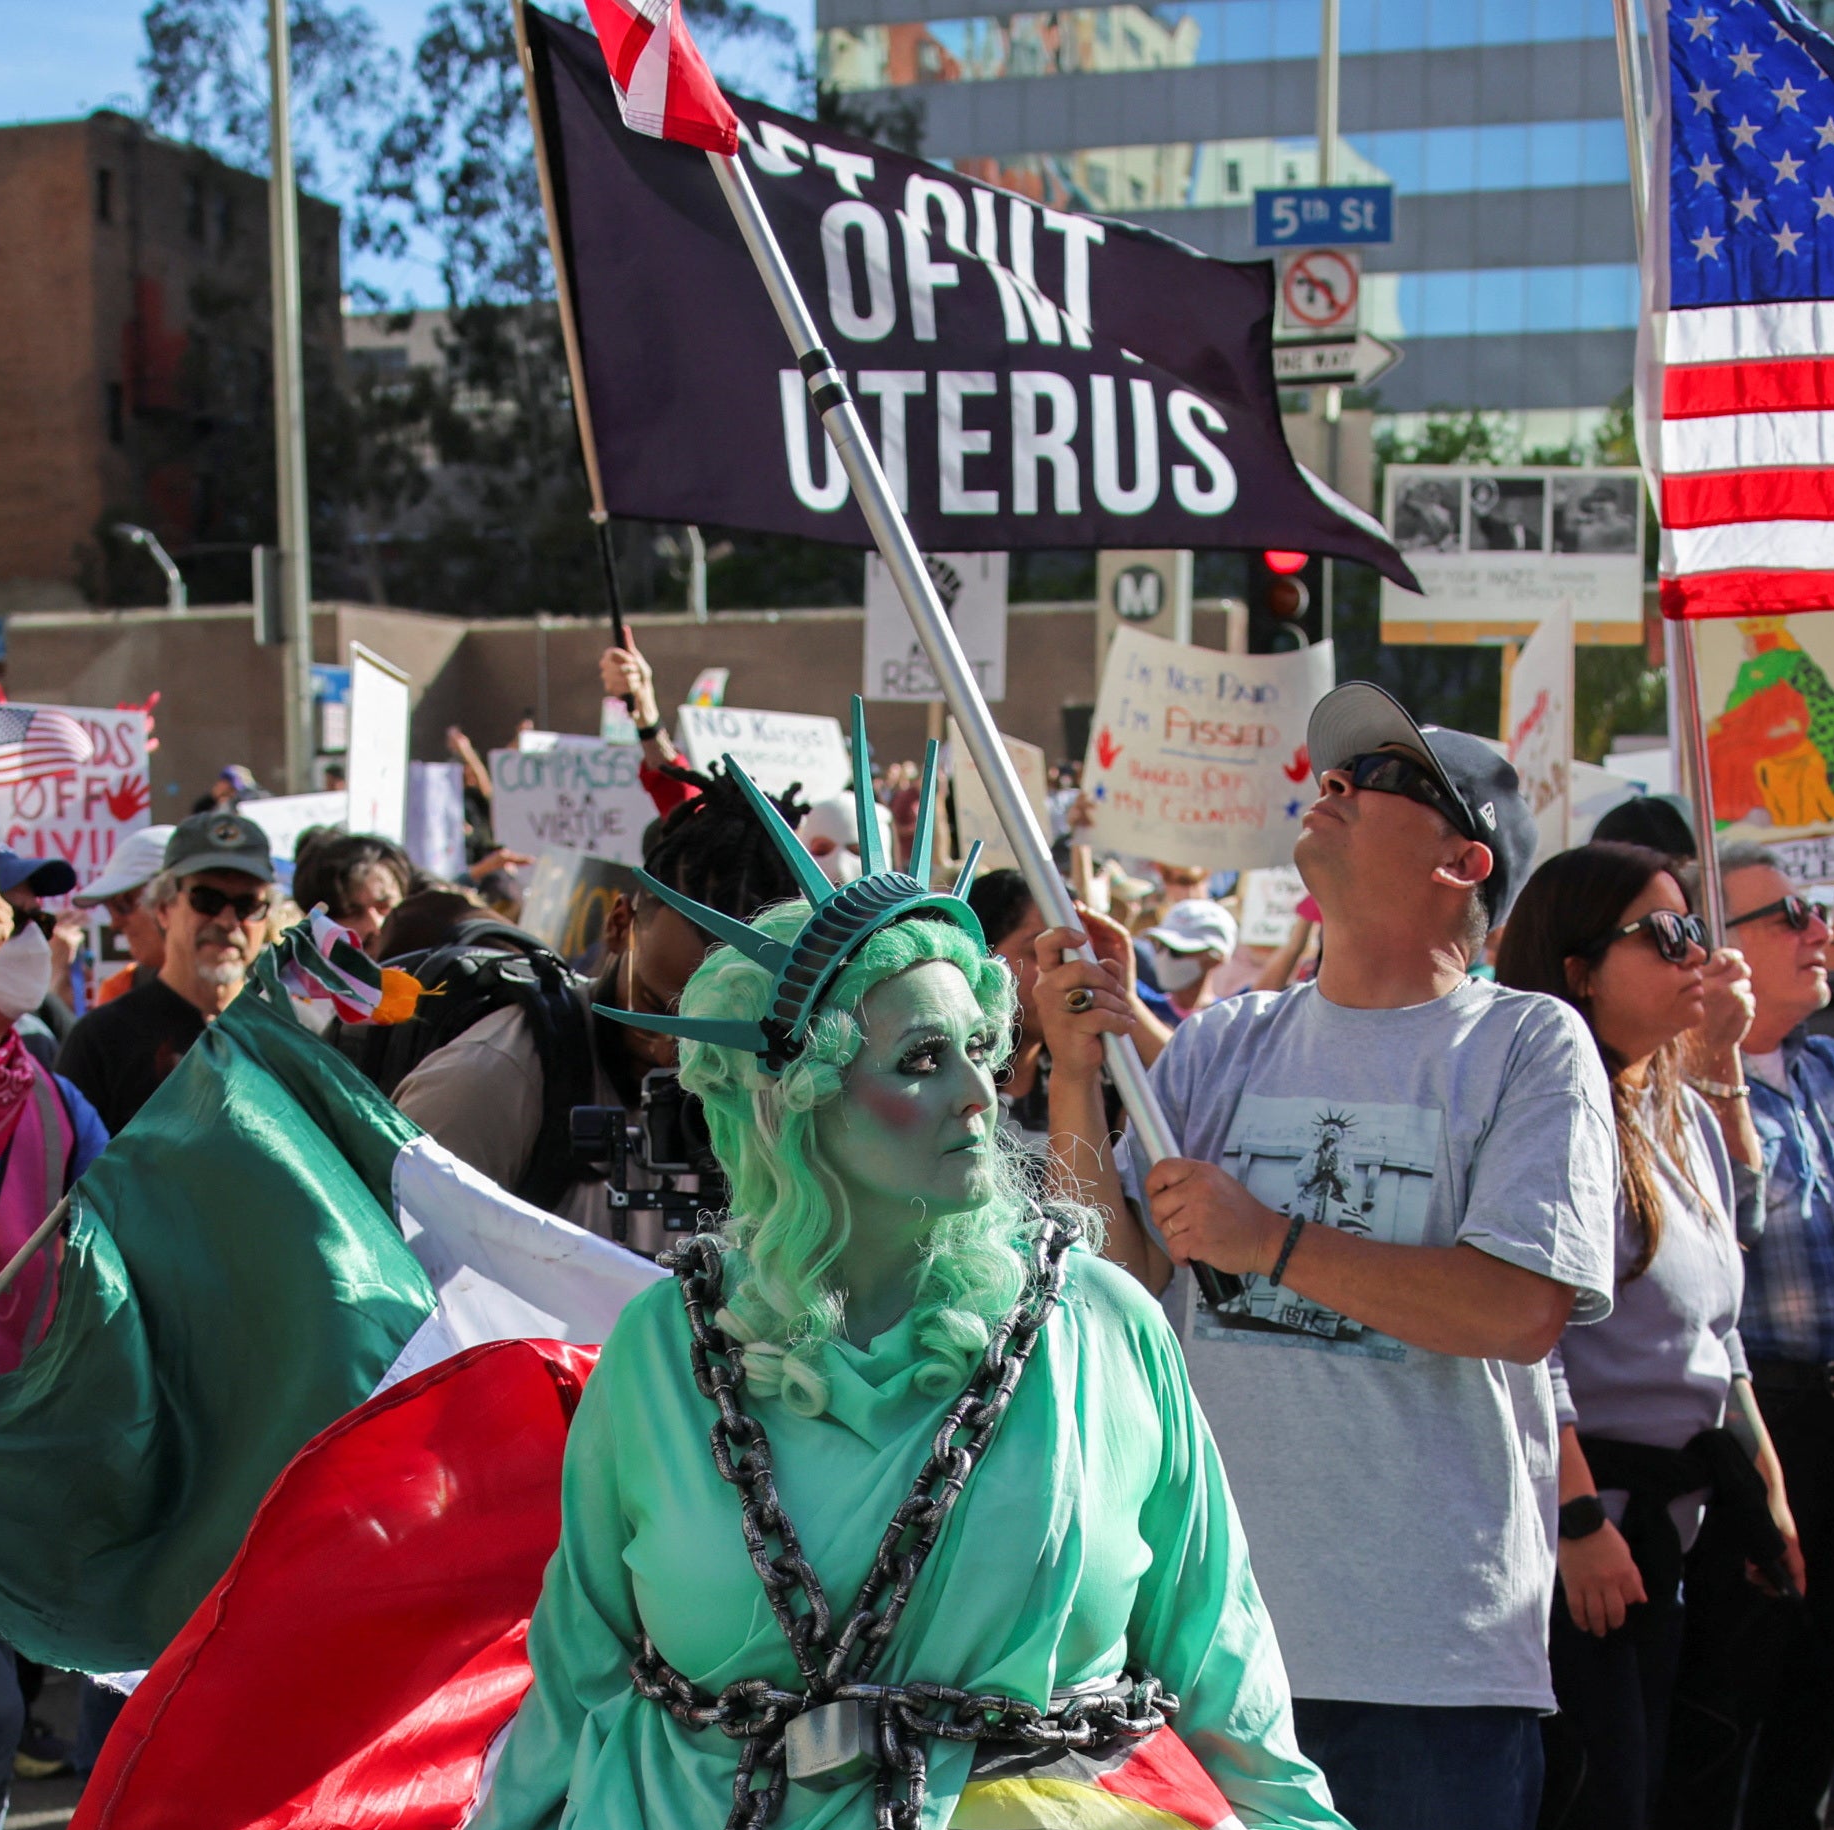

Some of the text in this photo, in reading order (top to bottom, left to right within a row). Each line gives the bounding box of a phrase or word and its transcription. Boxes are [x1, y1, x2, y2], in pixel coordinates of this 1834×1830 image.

[1272, 196, 1378, 239] 5th St
[1276, 353, 1304, 370] NE
[779, 368, 1239, 516] UTERUS
[1117, 572, 1158, 616] M
[881, 660, 994, 693] REST
[692, 709, 742, 739] NO
[1164, 705, 1281, 748] PISSED
[13, 776, 107, 820] OFF
[527, 808, 626, 838] VIRTUE
